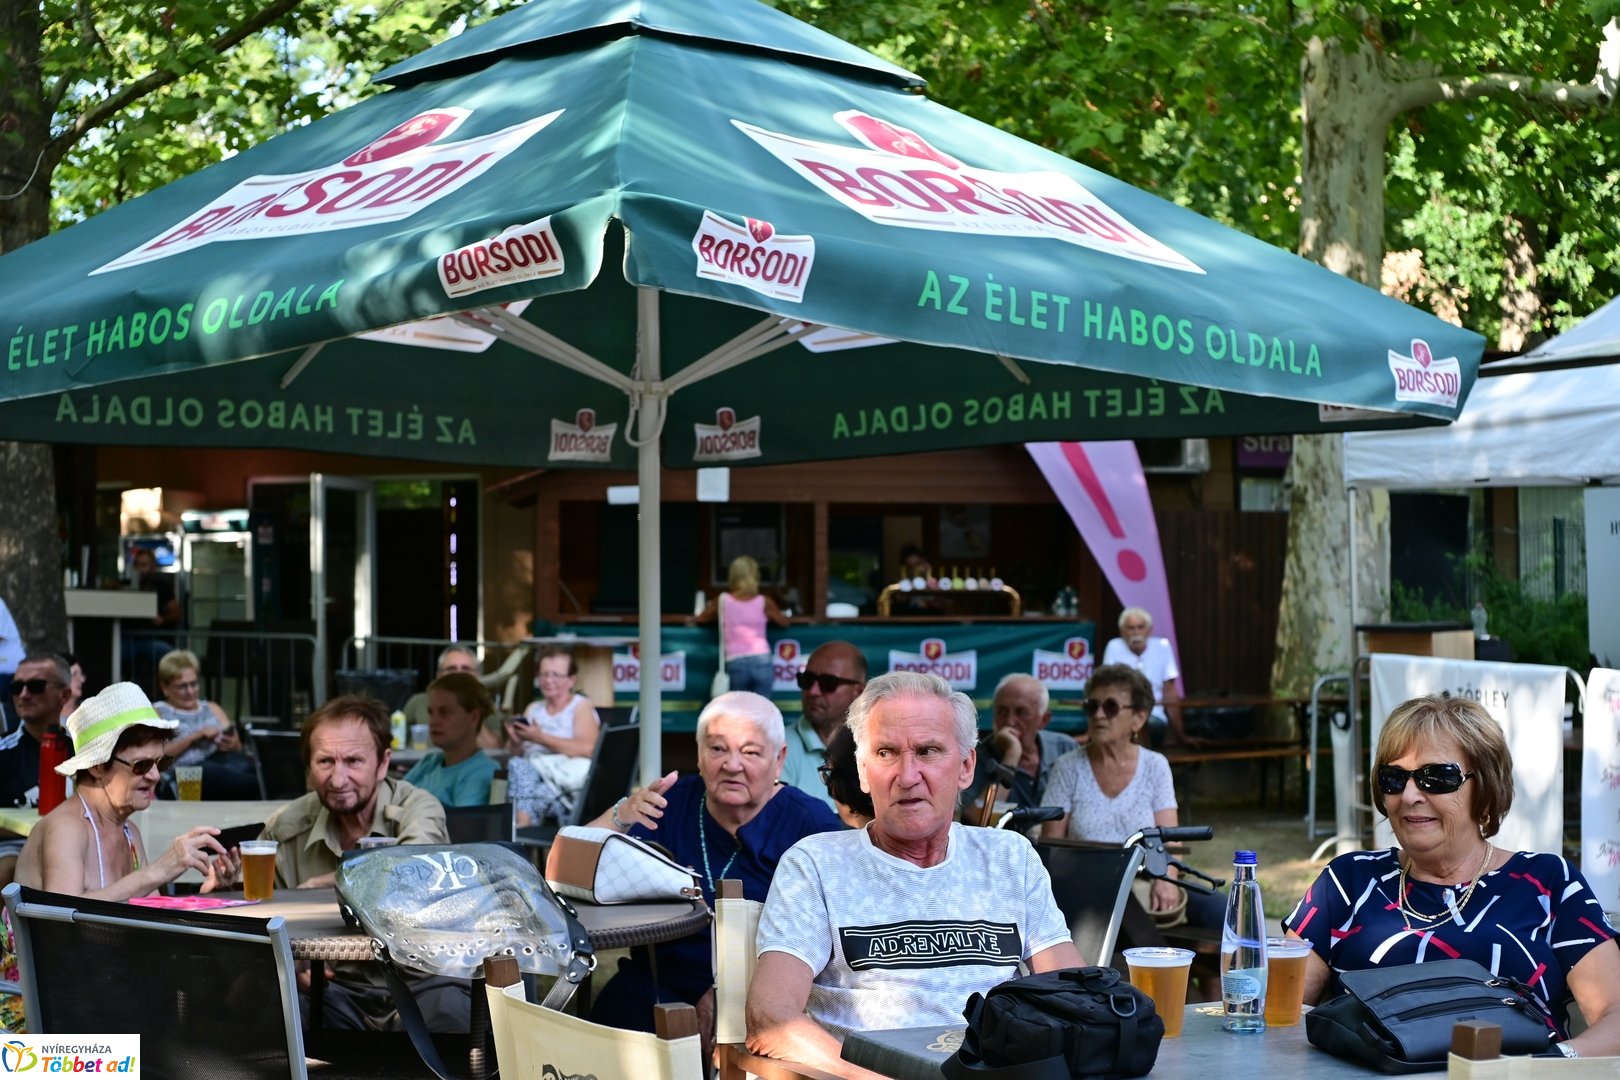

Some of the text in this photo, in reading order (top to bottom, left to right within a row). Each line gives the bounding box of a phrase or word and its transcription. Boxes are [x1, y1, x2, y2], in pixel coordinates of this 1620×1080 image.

[140, 151, 495, 252] BORSODI
[793, 157, 1154, 248] BORSODI
[443, 230, 558, 285] BORSODI
[699, 233, 808, 287] BORSODI
[8, 278, 345, 371] ÉLET HABOS OLDALA
[917, 270, 1322, 378] AZ ÉLET HABOS OLDALA
[1395, 367, 1458, 398] BORSODI
[1038, 662, 1095, 681] BORSO
